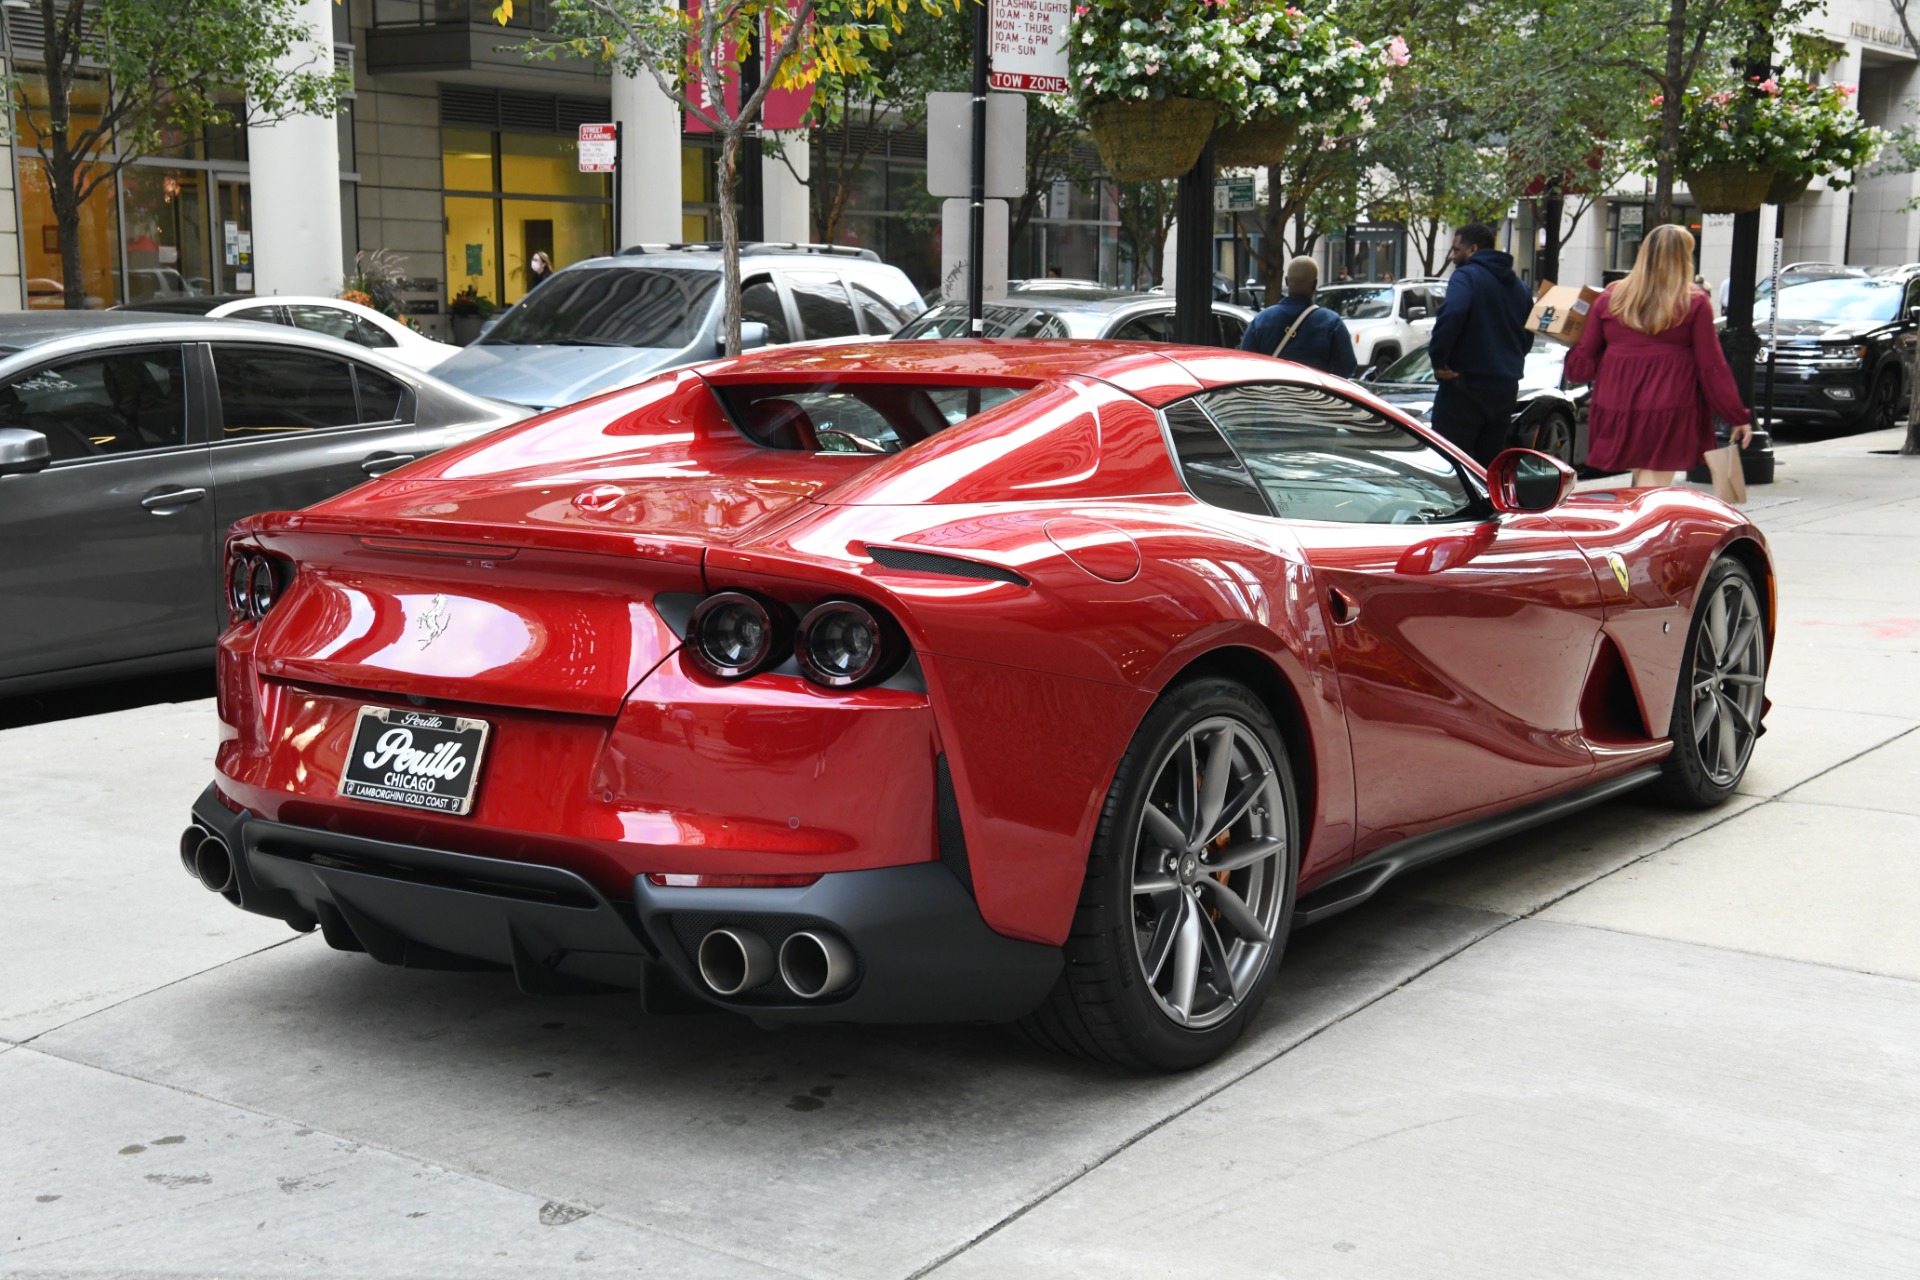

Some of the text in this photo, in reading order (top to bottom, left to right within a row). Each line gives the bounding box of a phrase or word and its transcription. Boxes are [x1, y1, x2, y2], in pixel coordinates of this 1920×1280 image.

[996, 0, 1068, 13] FLASHING LIGHTS
[996, 21, 1014, 30] MON
[1025, 23, 1053, 35] THURS
[995, 43, 1009, 53] FRI
[1018, 45, 1036, 56] SUN
[994, 73, 1063, 91] TOW ZONE
[1770, 240, 1780, 308] CONSIGNMENT
[401, 712, 442, 728] Perillo
[363, 728, 466, 780] Perillo
[384, 772, 436, 792] CHICAGO
[356, 786, 448, 808] LAMBORGHINI GOLD COAST
